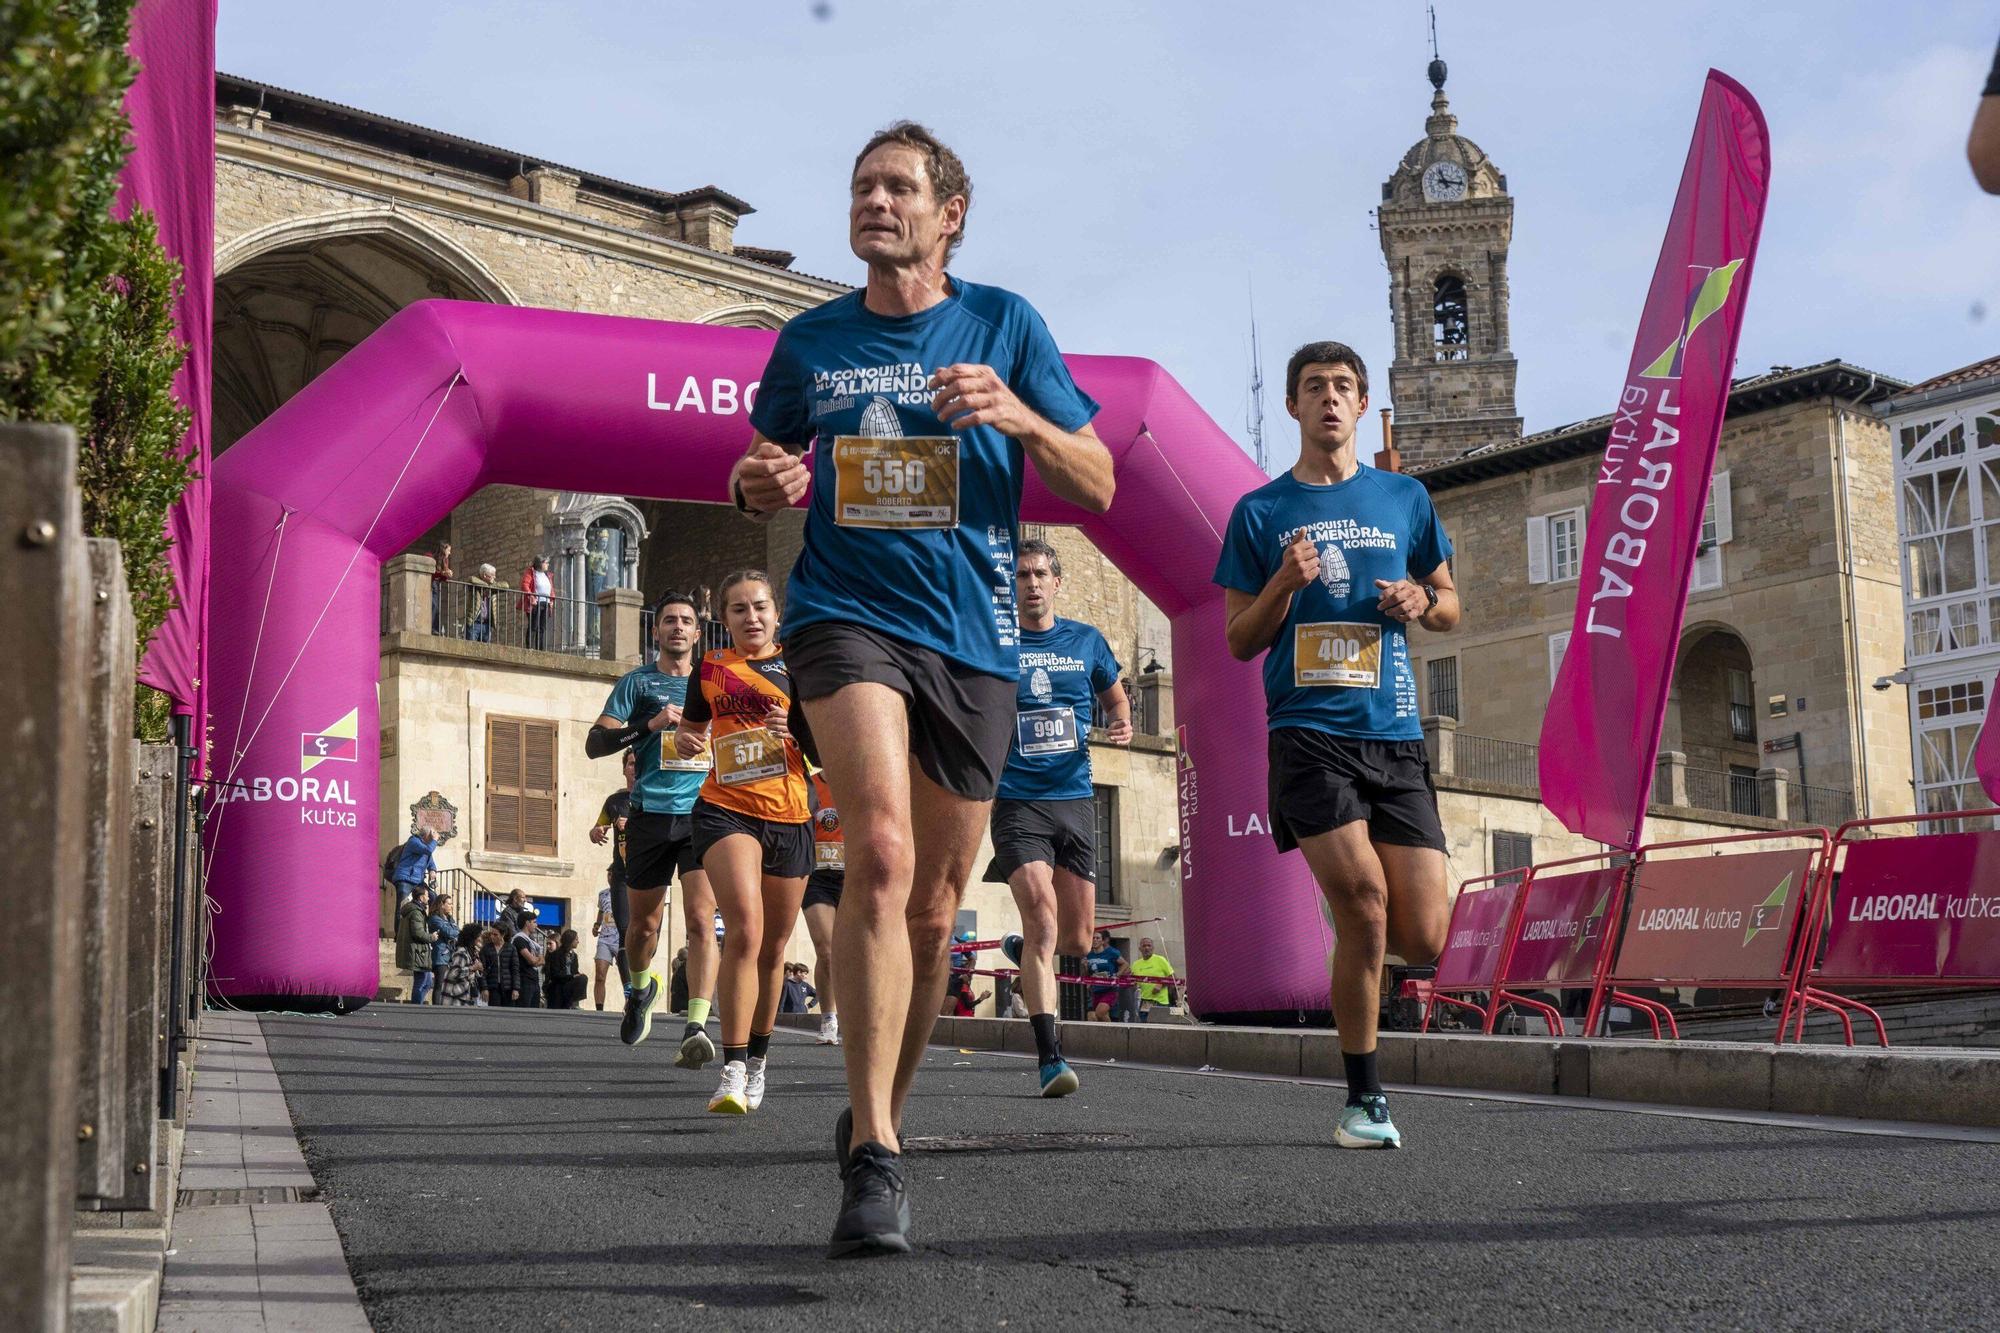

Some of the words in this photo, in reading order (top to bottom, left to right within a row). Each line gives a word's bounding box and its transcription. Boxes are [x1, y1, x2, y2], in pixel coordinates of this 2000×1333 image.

[814, 370, 829, 384] LA
[832, 363, 924, 382] CONQUISTA
[863, 460, 926, 494] 550
[876, 497, 912, 506] ROBERTO
[1278, 530, 1291, 542] LA
[1307, 526, 1382, 543] LMENDRA
[1343, 538, 1396, 550] KONKISTA
[1318, 638, 1360, 662] 400
[1034, 719, 1064, 737] 990
[735, 741, 762, 765] 577
[216, 777, 356, 805] LABORAL
[301, 807, 356, 827] kutxa
[1180, 774, 1193, 880] LABORAL
[1190, 771, 1198, 815] kutxa
[1227, 812, 1272, 837] LA
[821, 848, 838, 859] 702
[1849, 894, 1939, 922] LABORAL
[1944, 893, 2000, 920] kutxa
[1523, 918, 1556, 941] LABORAL
[1555, 919, 1578, 940] kutxa
[1638, 907, 1700, 931] LABORAL
[1703, 908, 1742, 929] kutxa
[1451, 928, 1473, 948] LABORAL
